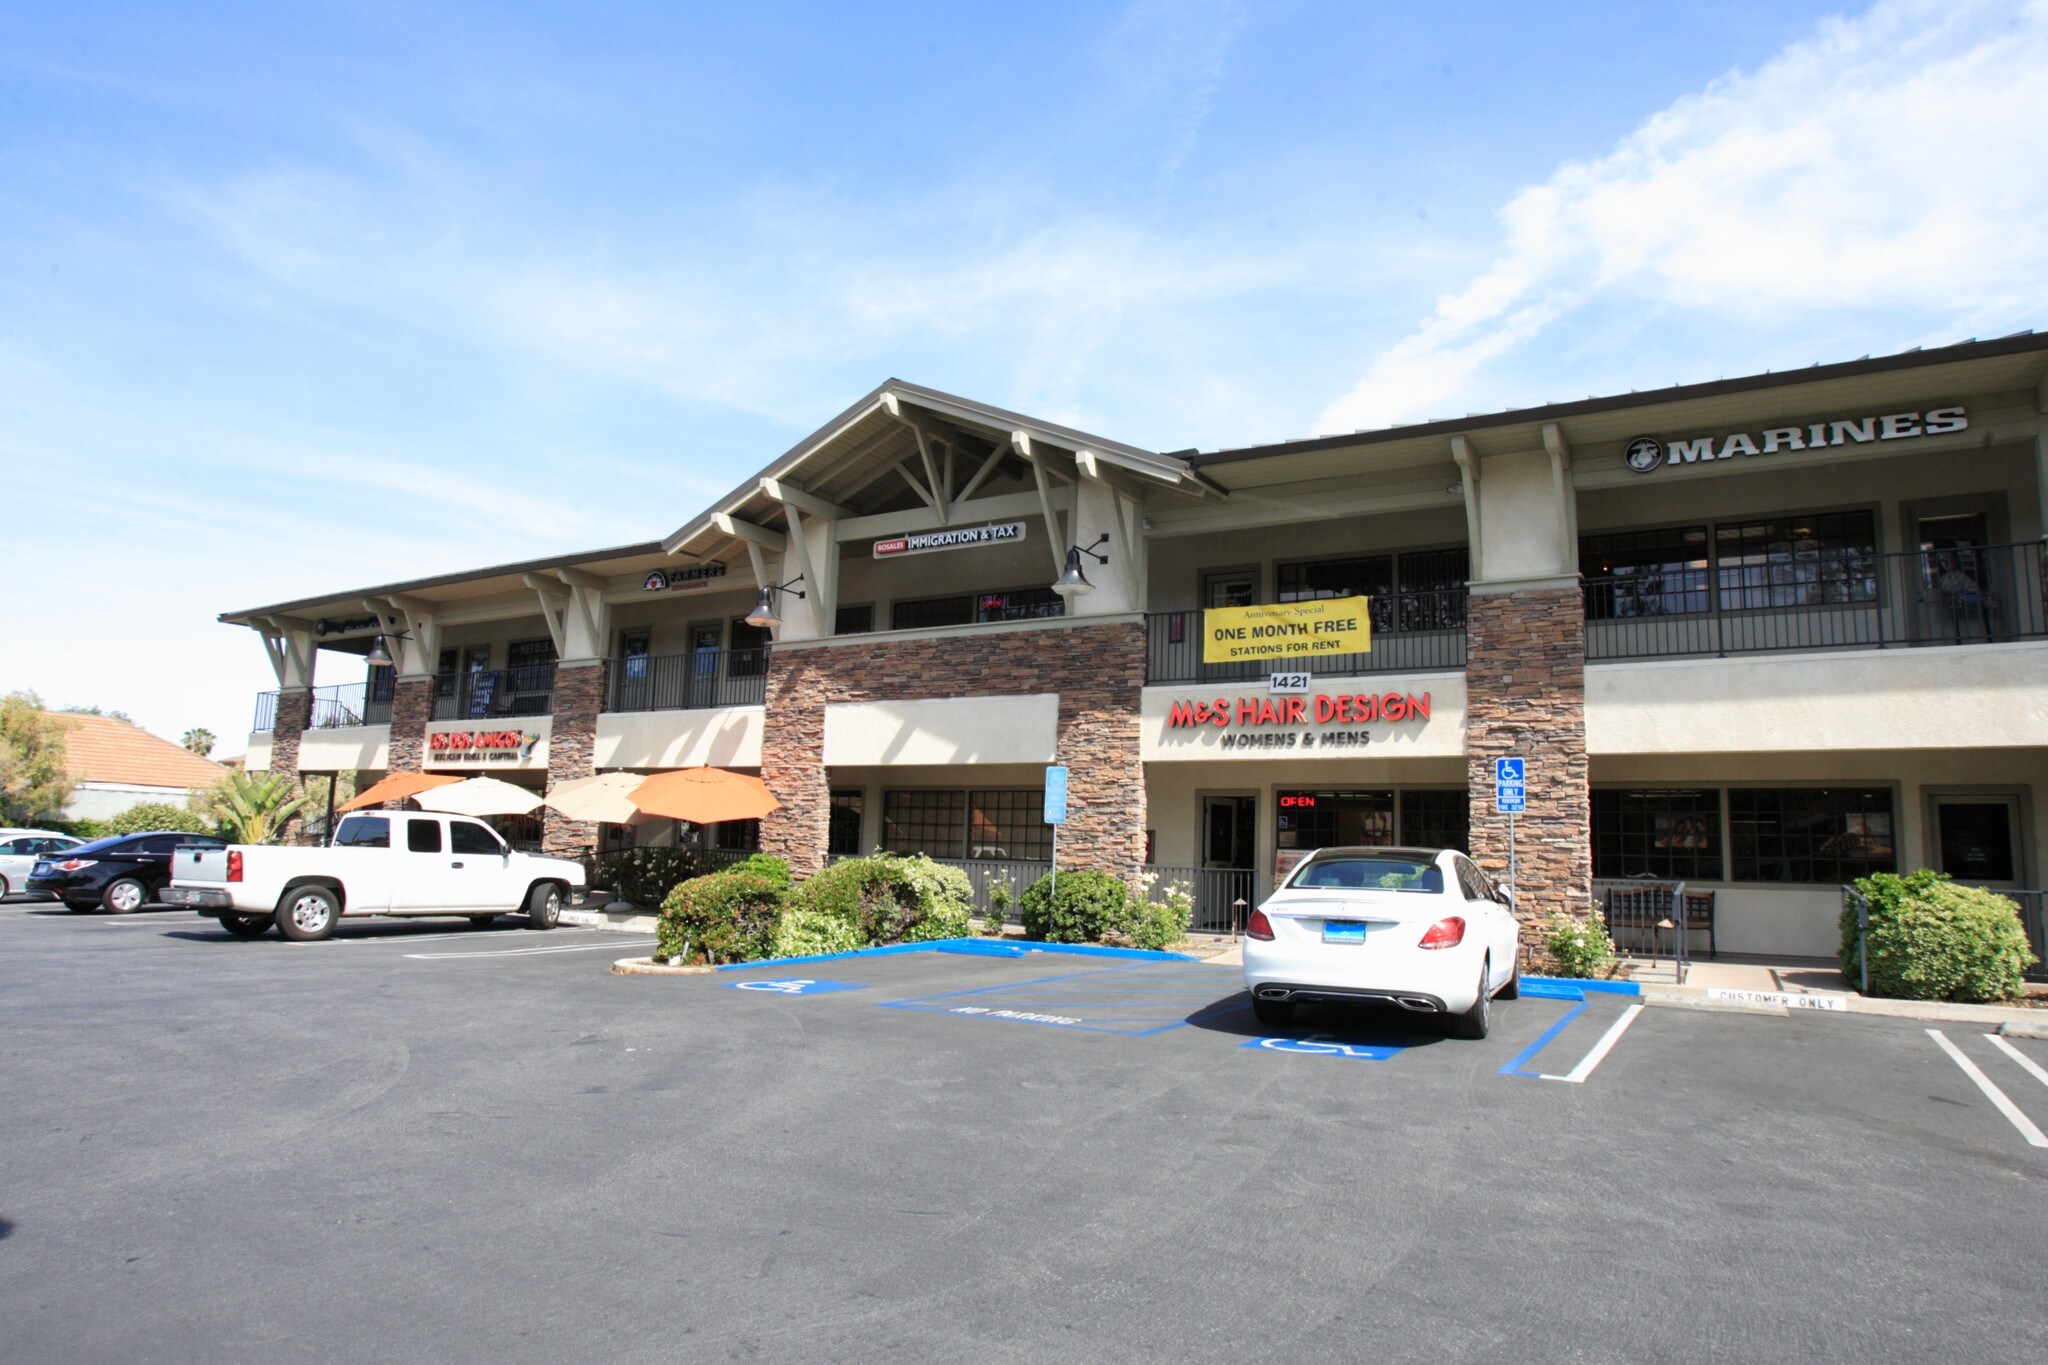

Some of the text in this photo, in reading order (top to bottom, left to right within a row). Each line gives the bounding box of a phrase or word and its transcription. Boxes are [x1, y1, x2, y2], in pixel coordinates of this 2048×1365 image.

[1667, 406, 1969, 465] MARINES
[877, 525, 1015, 552] ROSALES IMMIGRATION & TAX
[1242, 604, 1325, 620] Anniversary Special
[1214, 618, 1358, 641] ONE MONTH FREE
[1230, 639, 1341, 657] STATIONS FOR RENT
[1271, 676, 1307, 689] 1421
[1168, 692, 1431, 728] M&S HAIR DESIGN
[450, 732, 474, 749] DOS
[475, 730, 522, 749] AMIGOS
[1222, 731, 1370, 748] WOMENS & MENS
[1498, 779, 1523, 787] PARKING
[1503, 788, 1519, 796] ONLY
[1281, 797, 1315, 806] OPEN
[1799, 998, 1835, 1009] ONLY
